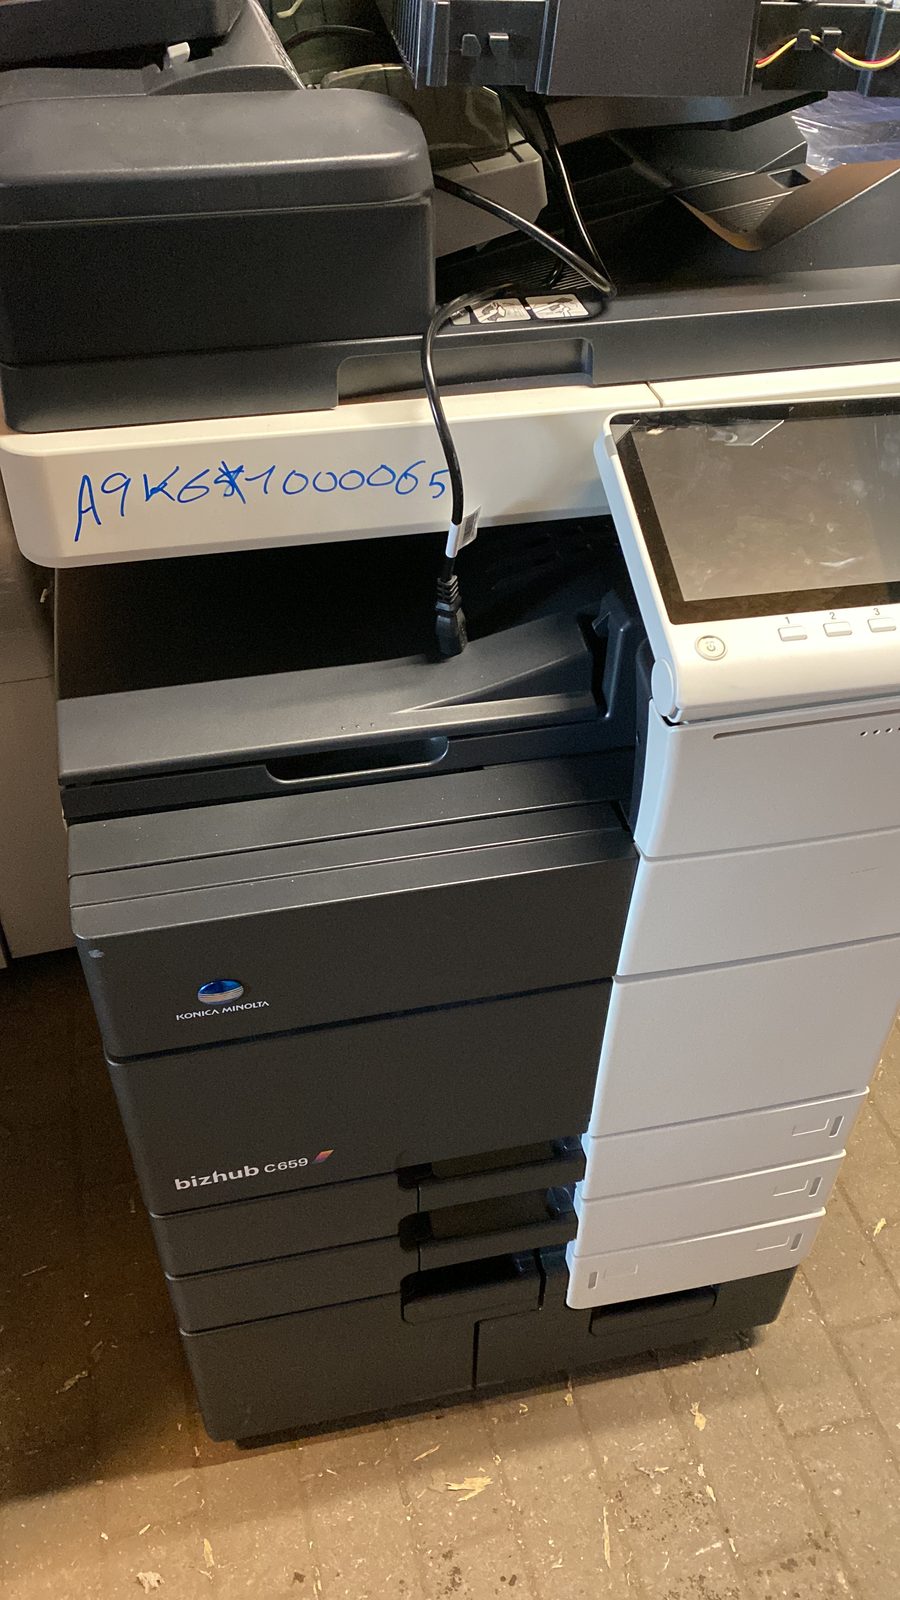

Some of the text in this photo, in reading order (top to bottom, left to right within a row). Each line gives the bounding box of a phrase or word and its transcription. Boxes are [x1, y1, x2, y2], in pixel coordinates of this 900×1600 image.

[829, 612, 836, 620] 2
[873, 608, 880, 616] 3
[176, 1001, 270, 1020] KONICA MINOLTA
[174, 1158, 308, 1190] bizhub C659
